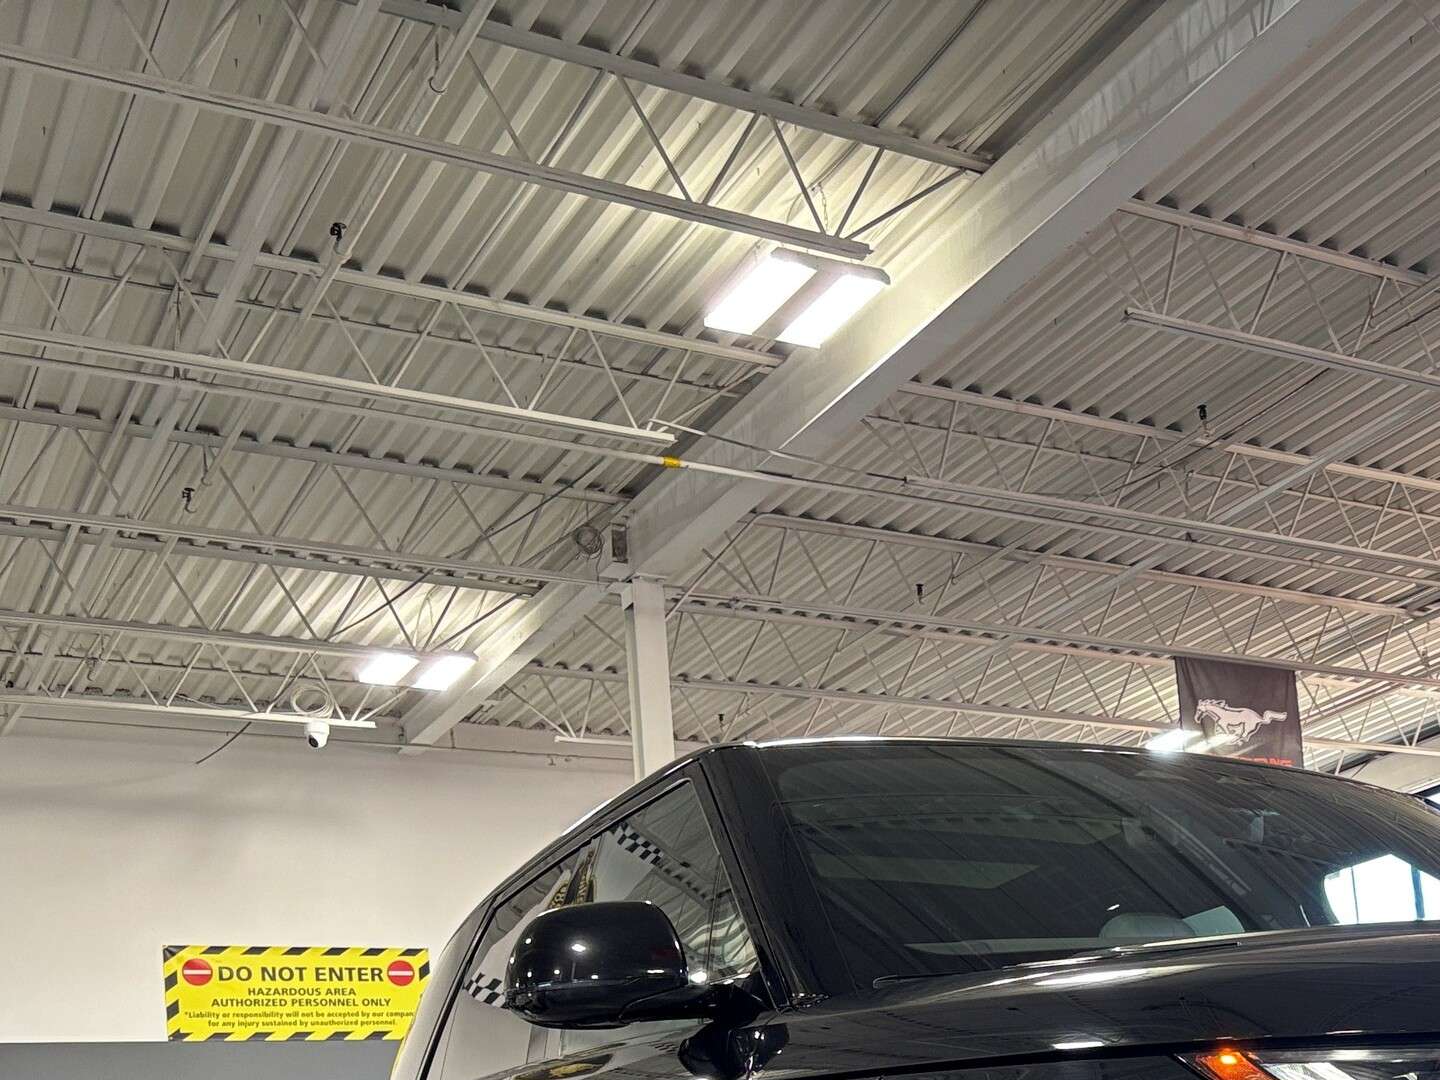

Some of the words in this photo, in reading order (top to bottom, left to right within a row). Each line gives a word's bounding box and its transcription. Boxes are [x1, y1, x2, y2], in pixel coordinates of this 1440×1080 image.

[218, 966, 252, 982] DO
[260, 966, 307, 982] NOT
[315, 967, 384, 982] ENTER
[248, 987, 321, 996] HAZARDOUS
[325, 987, 357, 996] AREA
[211, 998, 287, 1007] AUTHORIZED
[291, 998, 359, 1007] PERSONNEL
[362, 998, 392, 1007] ONLY
[232, 1011, 284, 1019] responsibility
[326, 1011, 360, 1019] accepted
[361, 1011, 370, 1019] by
[237, 1020, 260, 1028] injury
[261, 1019, 297, 1027] sustained
[299, 1019, 308, 1027] by
